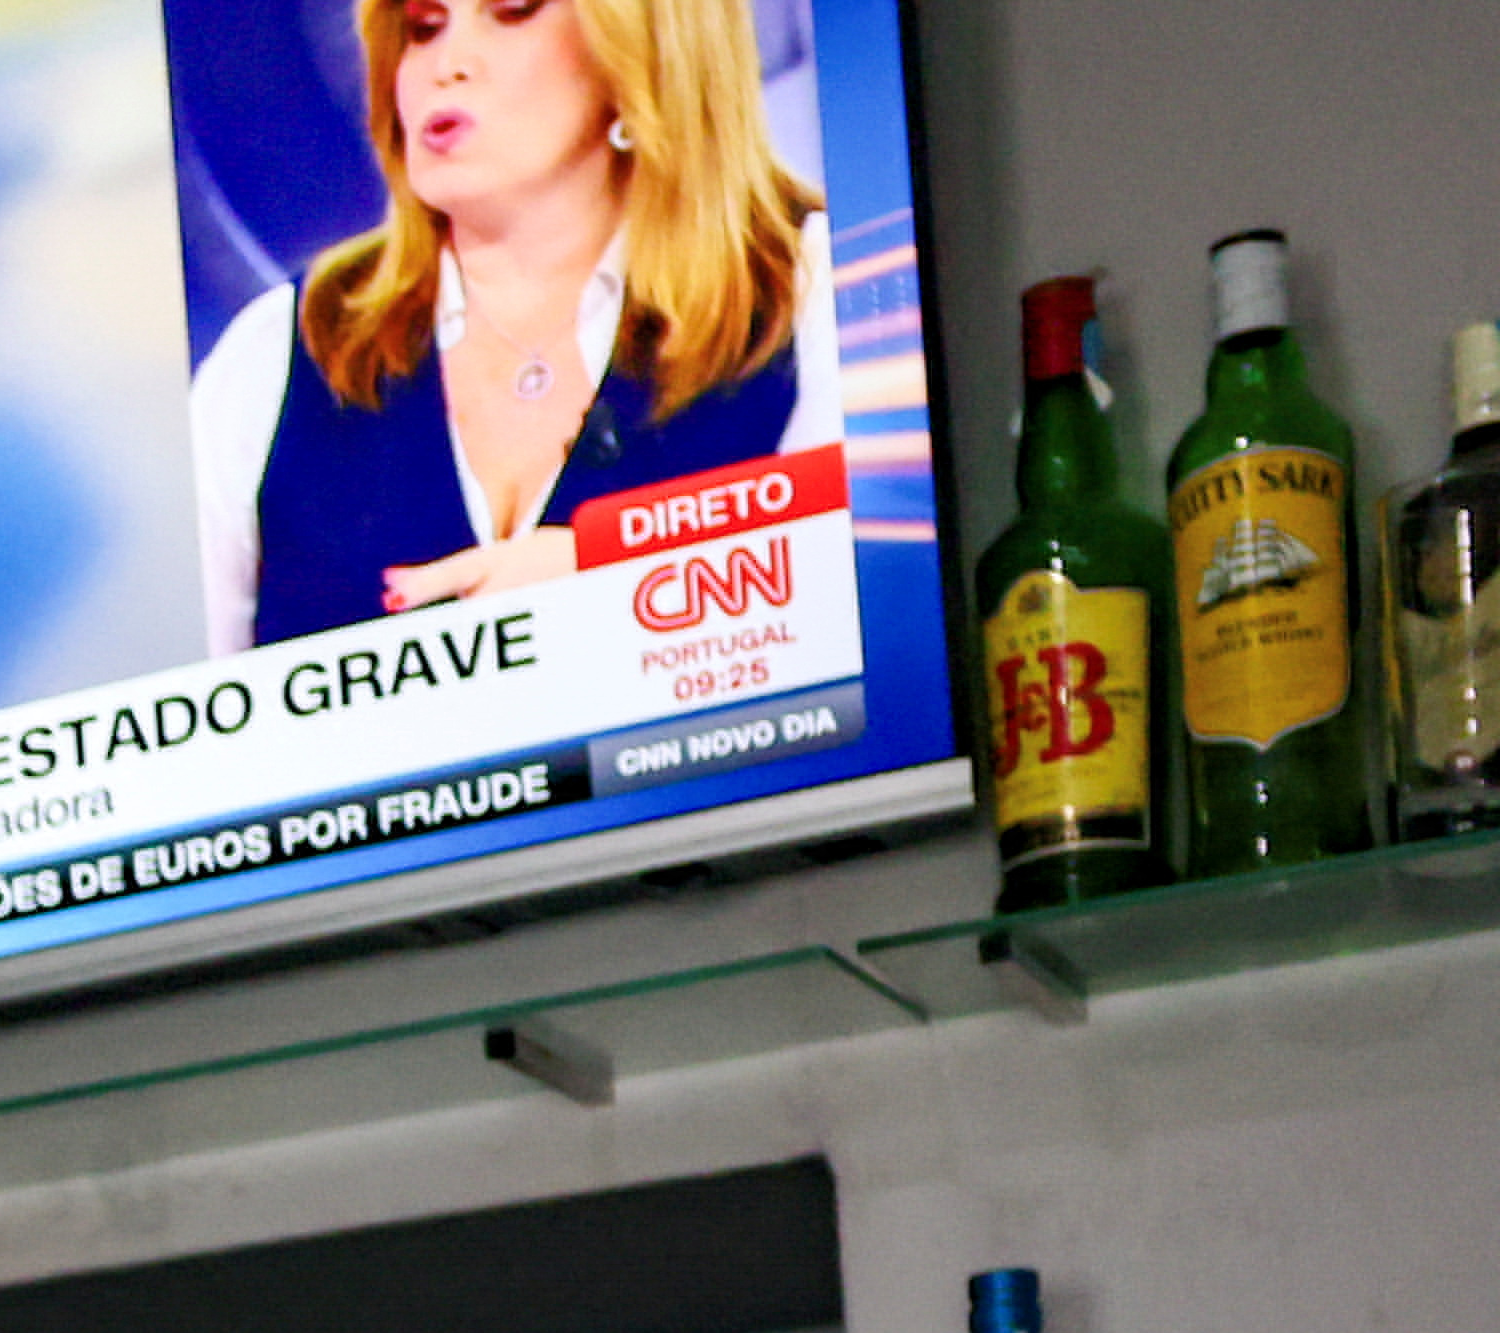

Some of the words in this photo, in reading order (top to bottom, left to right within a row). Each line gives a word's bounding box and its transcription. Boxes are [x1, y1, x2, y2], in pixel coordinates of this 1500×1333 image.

[619, 473, 794, 545] DIRETO
[632, 535, 794, 633] CNN
[284, 612, 536, 716] GRAVE
[642, 624, 796, 675] PORTUGAL
[674, 662, 770, 701] 09:25
[615, 736, 685, 777] CNN
[690, 720, 775, 764] NOVO
[783, 707, 838, 743] DIA
[990, 641, 1116, 782] J&B
[69, 857, 124, 902] DE
[133, 824, 272, 888] EUROS
[281, 803, 368, 855] POR
[378, 764, 551, 836] FRAUDE
